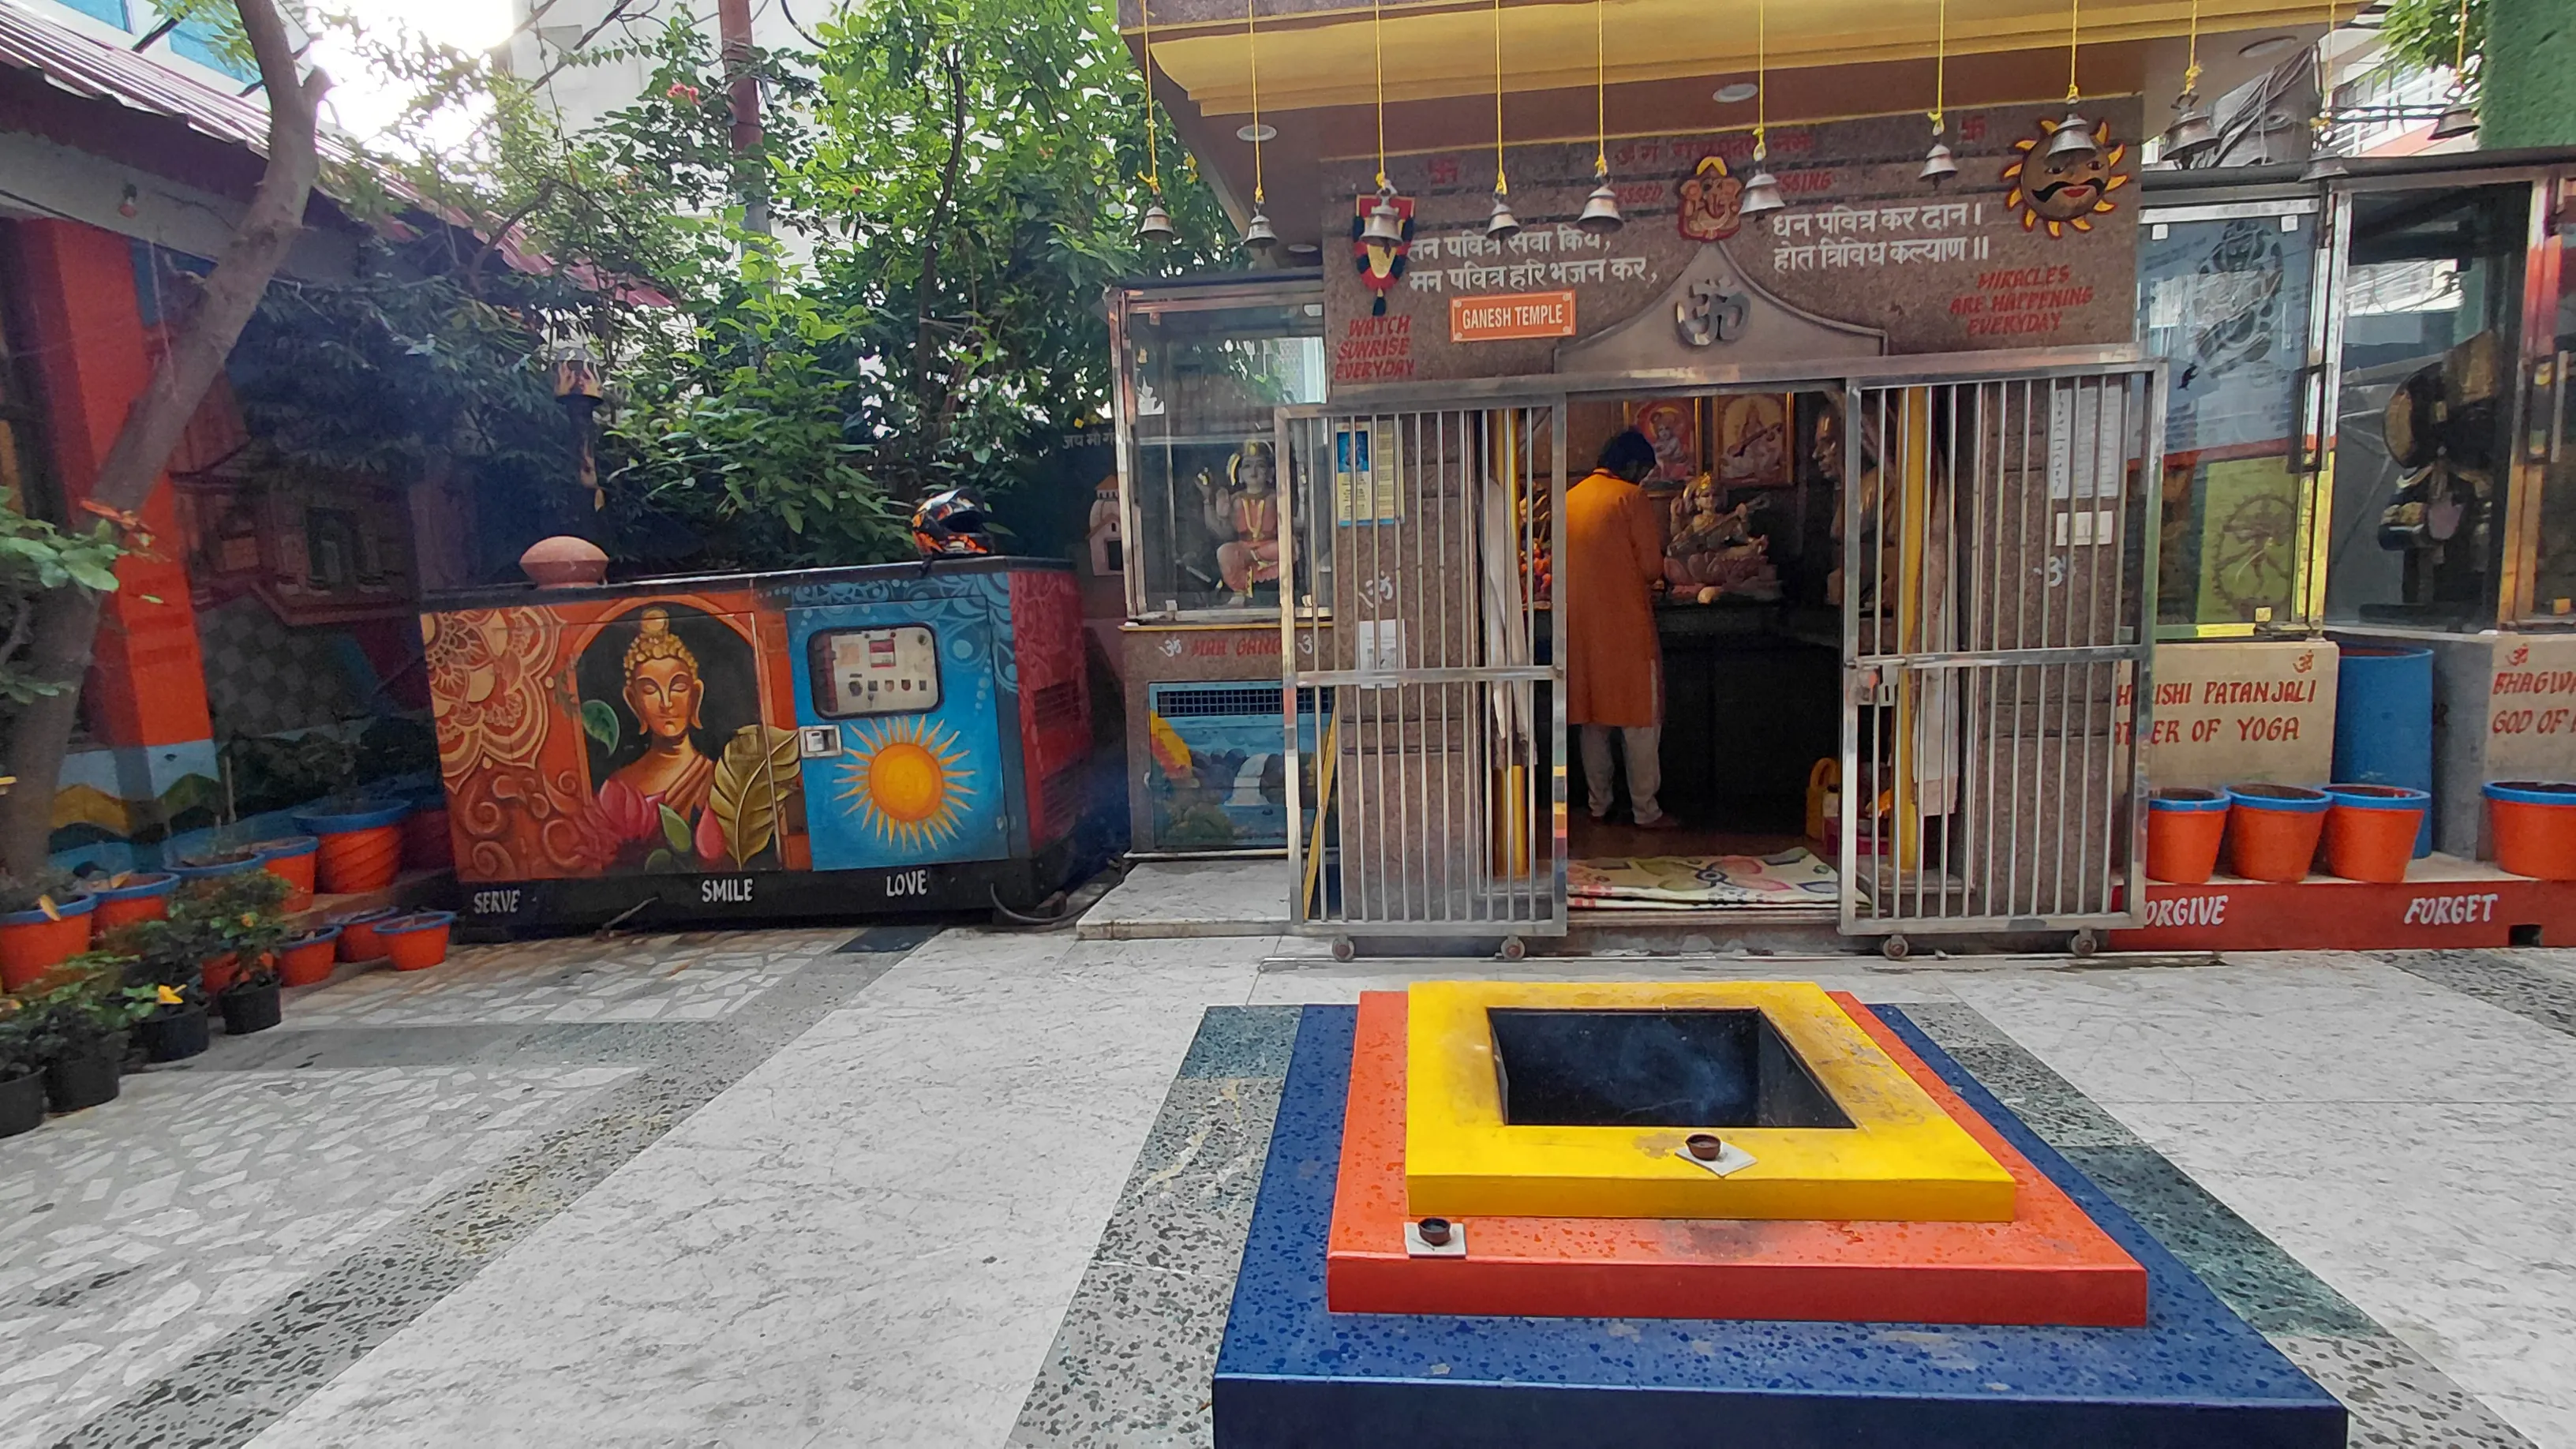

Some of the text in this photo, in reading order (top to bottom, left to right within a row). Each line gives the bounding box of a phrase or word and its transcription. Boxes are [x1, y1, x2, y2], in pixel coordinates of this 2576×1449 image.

[1773, 213, 1813, 237] धन
[1880, 207, 1919, 231] कर
[1409, 268, 1443, 294] मन
[1447, 260, 1507, 291] पवित्र
[1509, 258, 1548, 292] हरि
[1550, 258, 1608, 284] भजन
[1349, 315, 1412, 337] WATCH
[1462, 303, 1563, 330] GANESH TEMPLE
[1338, 337, 1410, 361] SUNRISE
[1335, 358, 1415, 380] EVERYDAY
[2192, 718, 2222, 743] OF
[2237, 716, 2301, 742] YOGA
[2492, 710, 2533, 734] GOD
[2537, 709, 2570, 735] OF
[701, 878, 754, 904] SMILE
[886, 870, 928, 898] LOVE
[474, 889, 522, 915] SERVE
[2145, 894, 2230, 927] ORGIVE
[2403, 893, 2499, 926] FORGET
